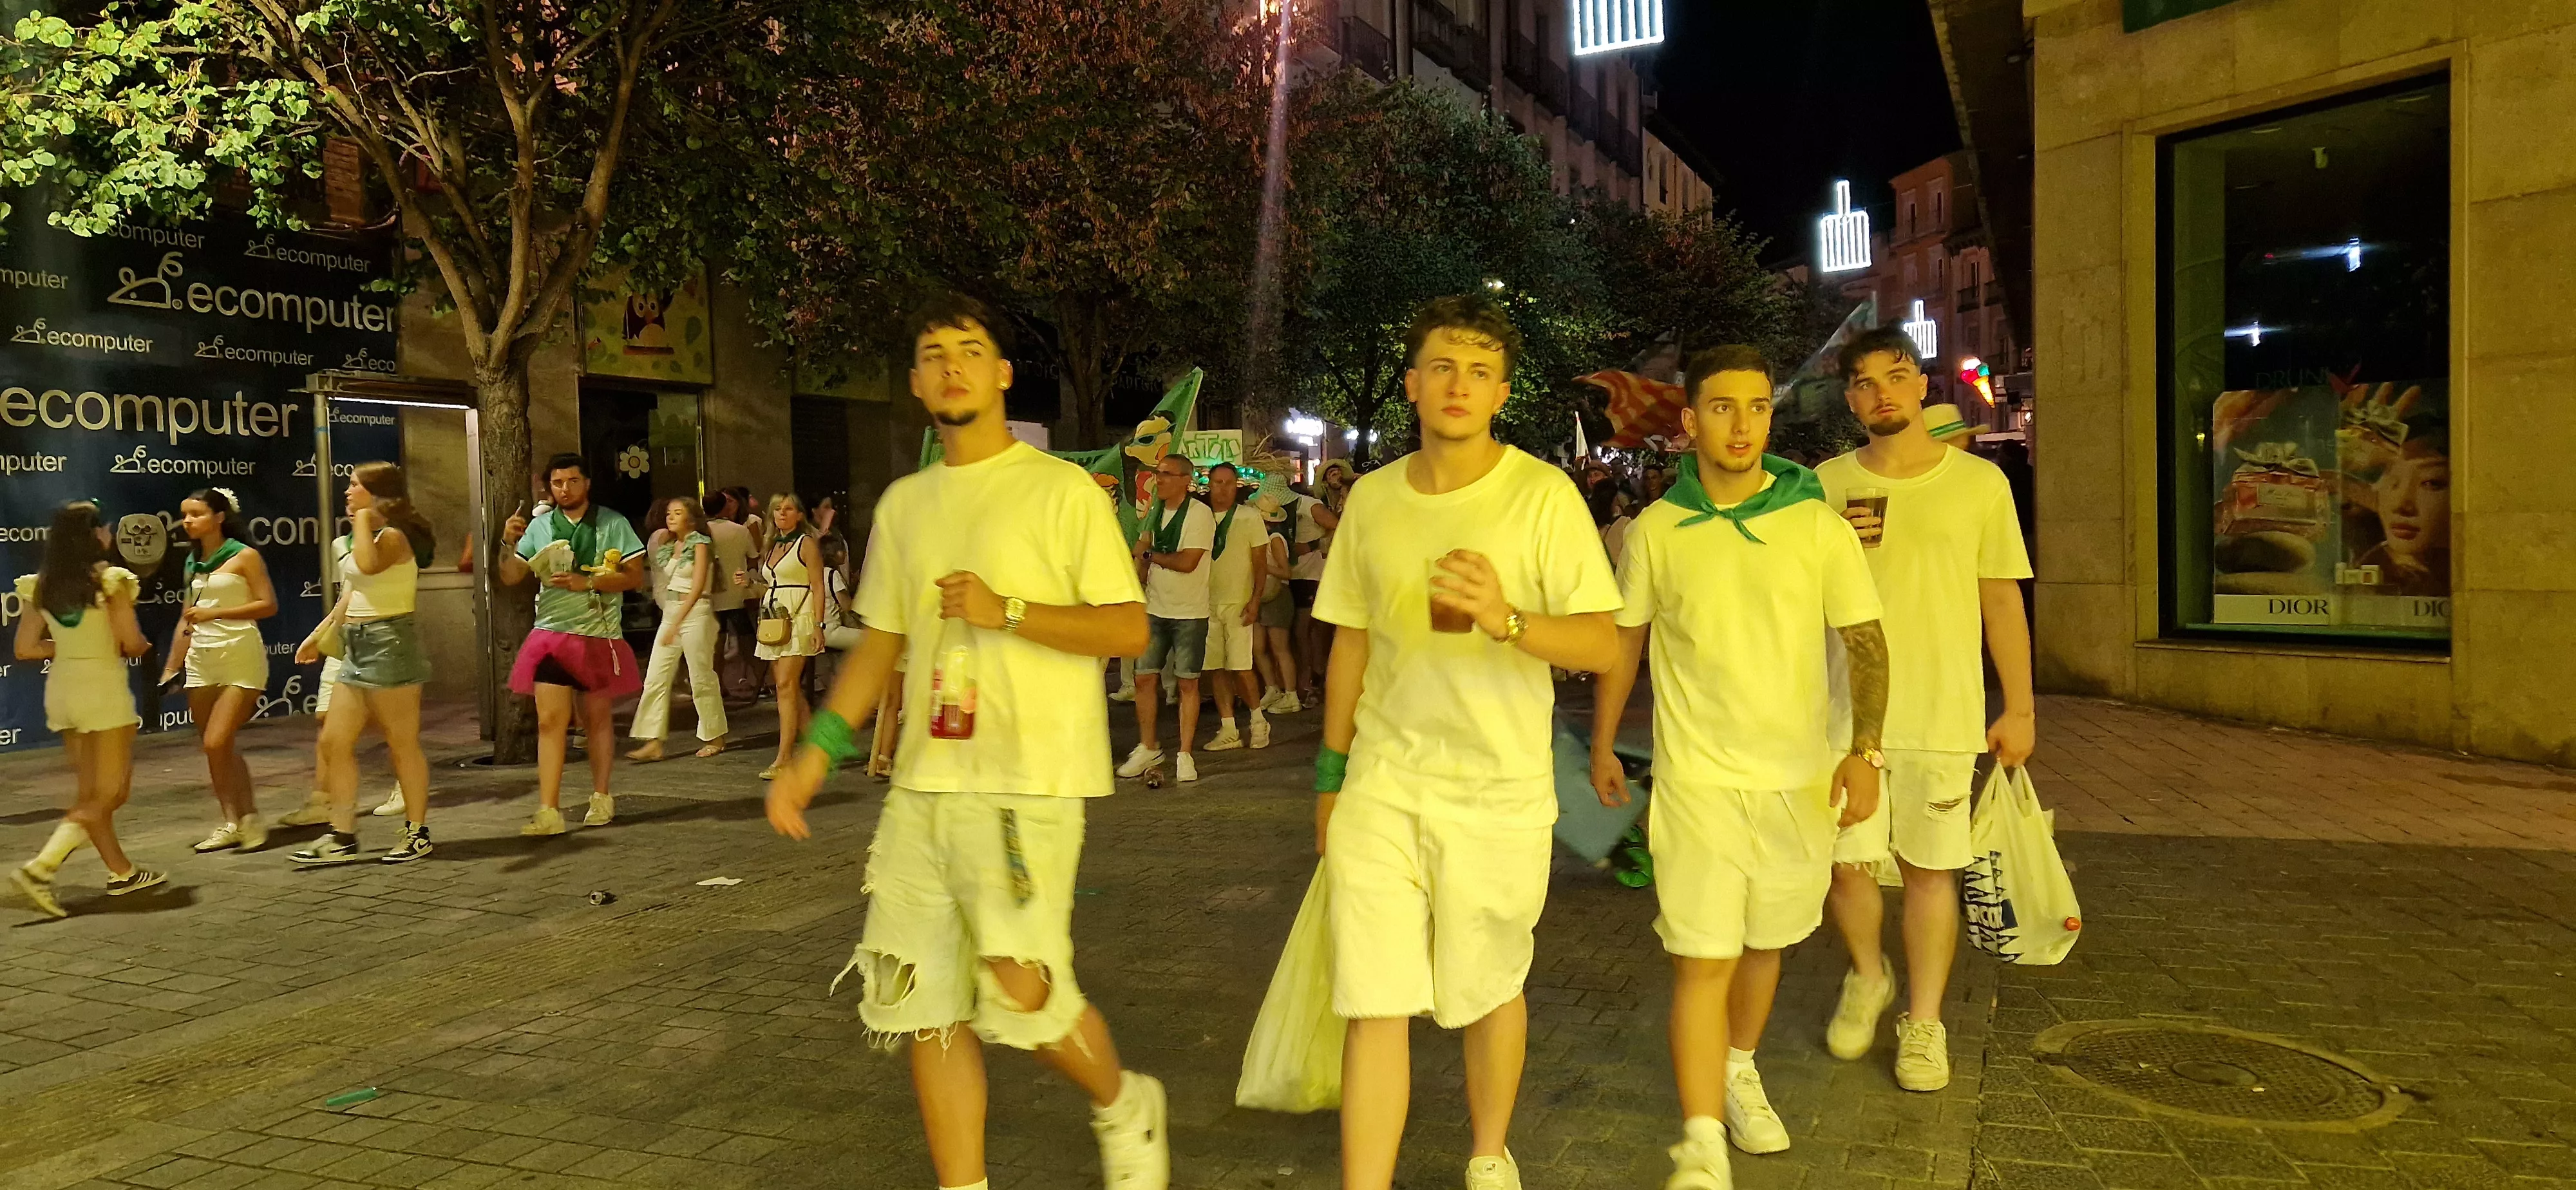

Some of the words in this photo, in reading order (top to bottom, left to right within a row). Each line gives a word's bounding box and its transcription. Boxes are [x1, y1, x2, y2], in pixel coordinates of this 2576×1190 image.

[276, 247, 372, 273] ecomputer
[187, 281, 394, 334] ecomputer
[46, 330, 153, 354] ecomputer
[224, 346, 314, 368] ecomputer
[0, 386, 299, 446] ecomputer
[339, 413, 395, 426] ecomputer
[147, 457, 256, 478] ecomputer
[2268, 599, 2329, 615] DIOR
